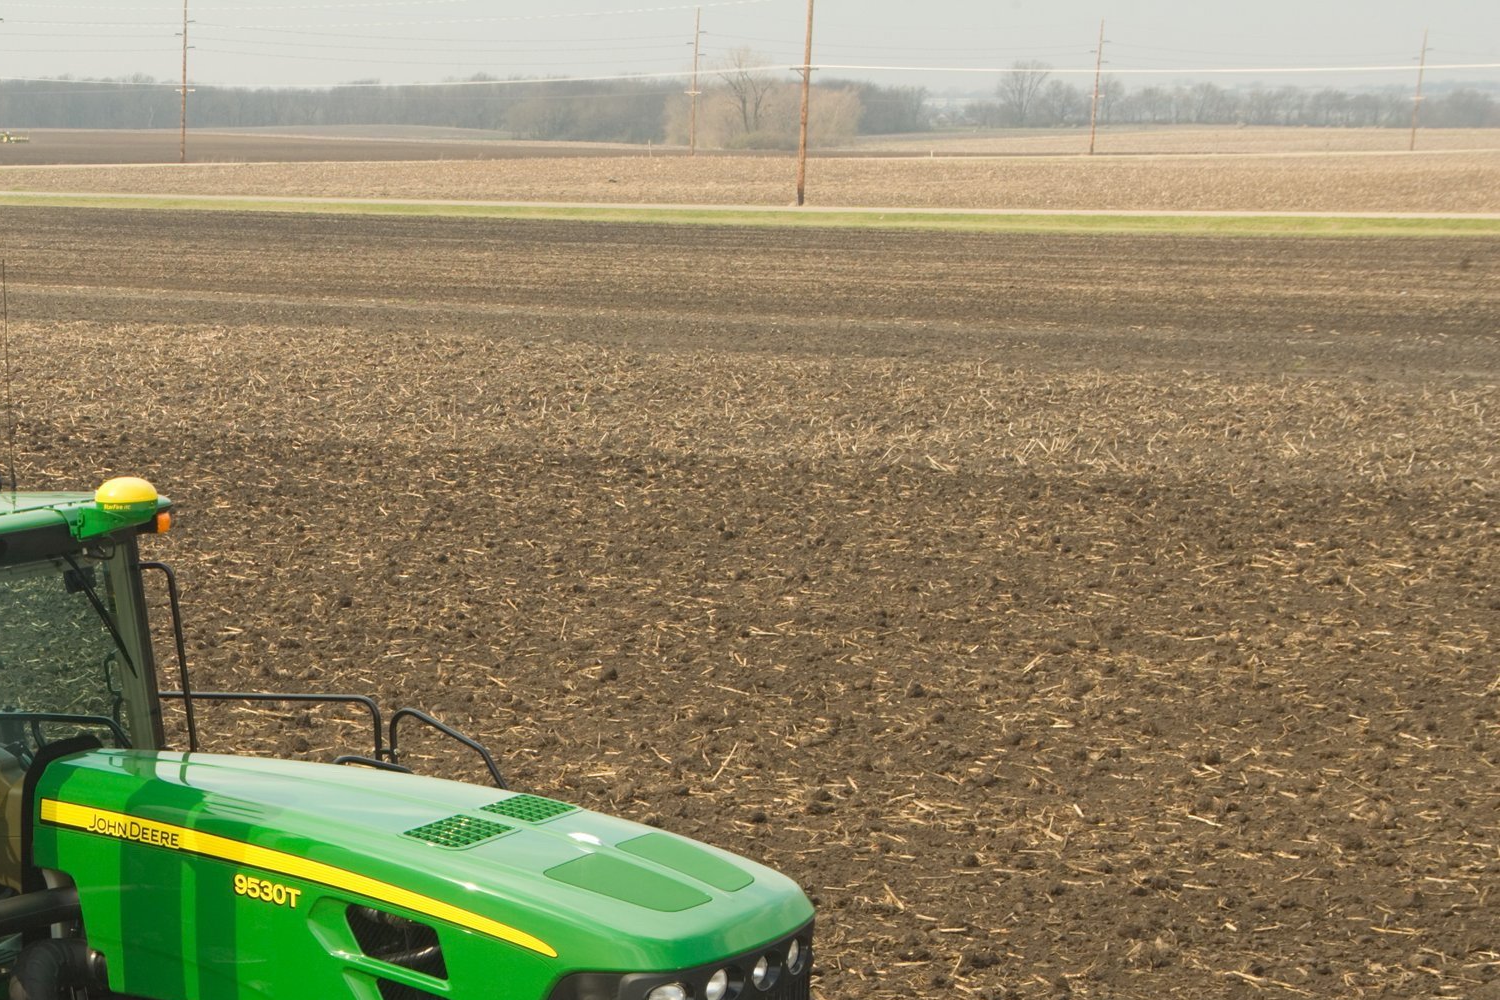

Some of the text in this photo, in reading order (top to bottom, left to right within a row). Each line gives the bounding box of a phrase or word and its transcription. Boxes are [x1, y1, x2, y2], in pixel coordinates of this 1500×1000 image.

[89, 814, 179, 847] JOHN DEERE
[234, 873, 301, 908] 9530T
